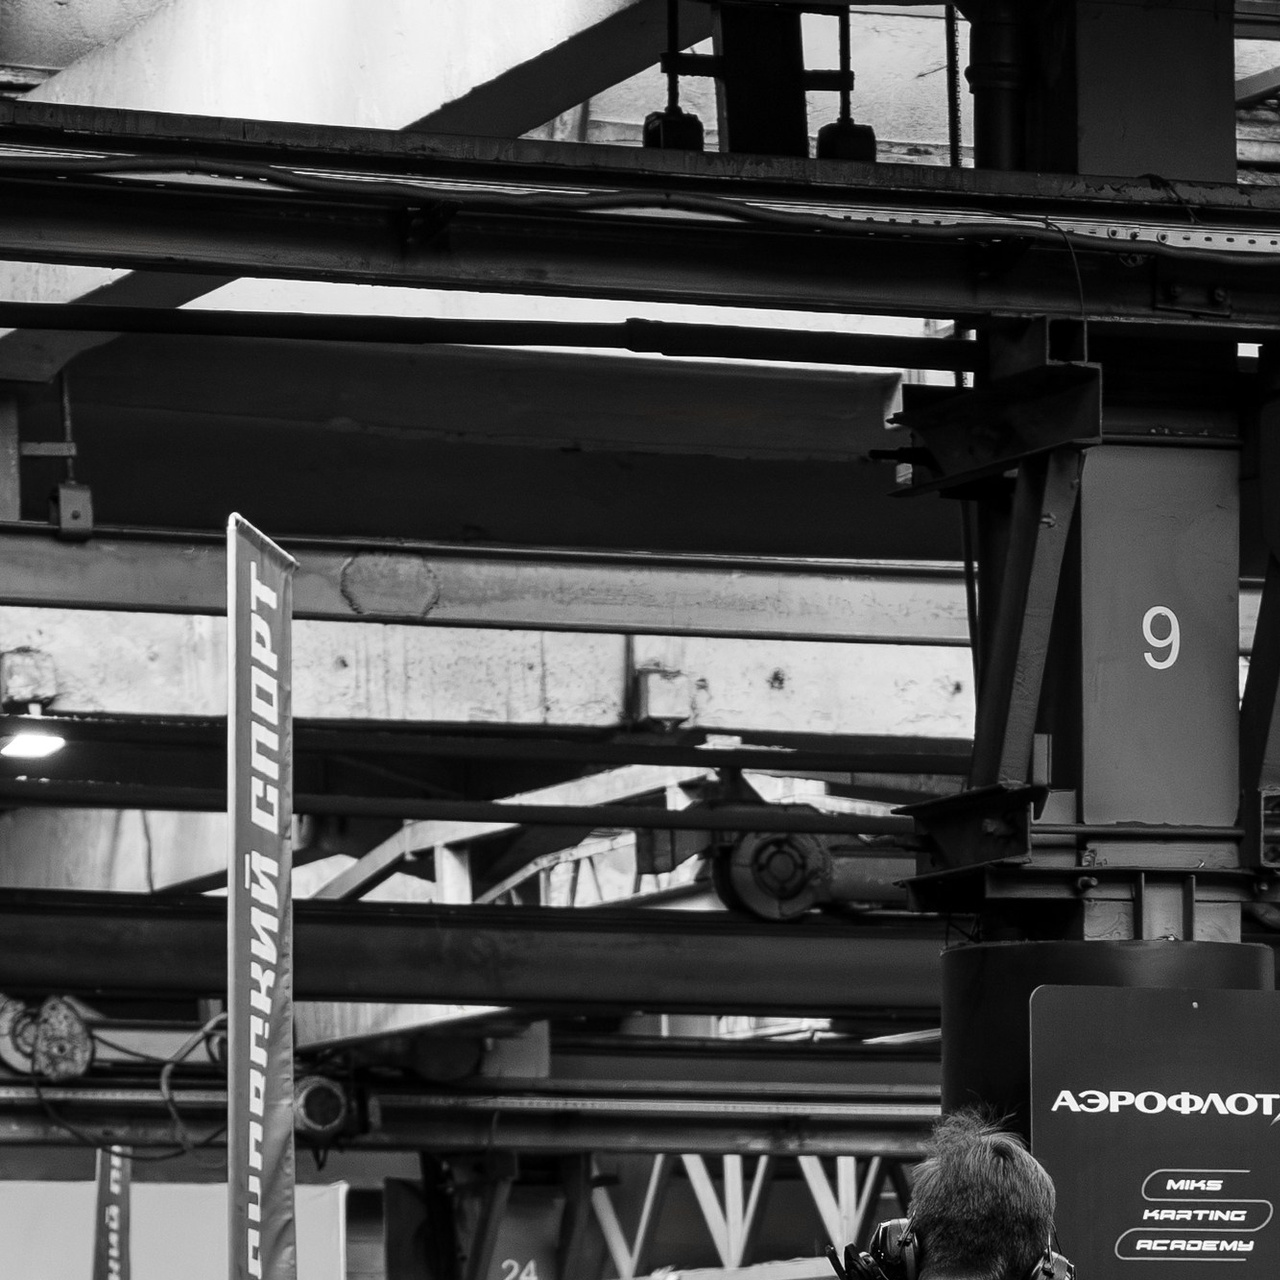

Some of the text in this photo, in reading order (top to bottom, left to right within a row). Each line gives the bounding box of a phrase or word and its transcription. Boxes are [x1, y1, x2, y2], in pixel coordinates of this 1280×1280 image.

[1142, 604, 1181, 670] 9
[250, 561, 279, 835] СПОРТ
[1051, 1090, 1280, 1116] АЭРОФЛОТ
[1166, 1179, 1224, 1191] MIKS
[1143, 1209, 1247, 1221] KARTING
[1136, 1240, 1255, 1251] ACADEMY
